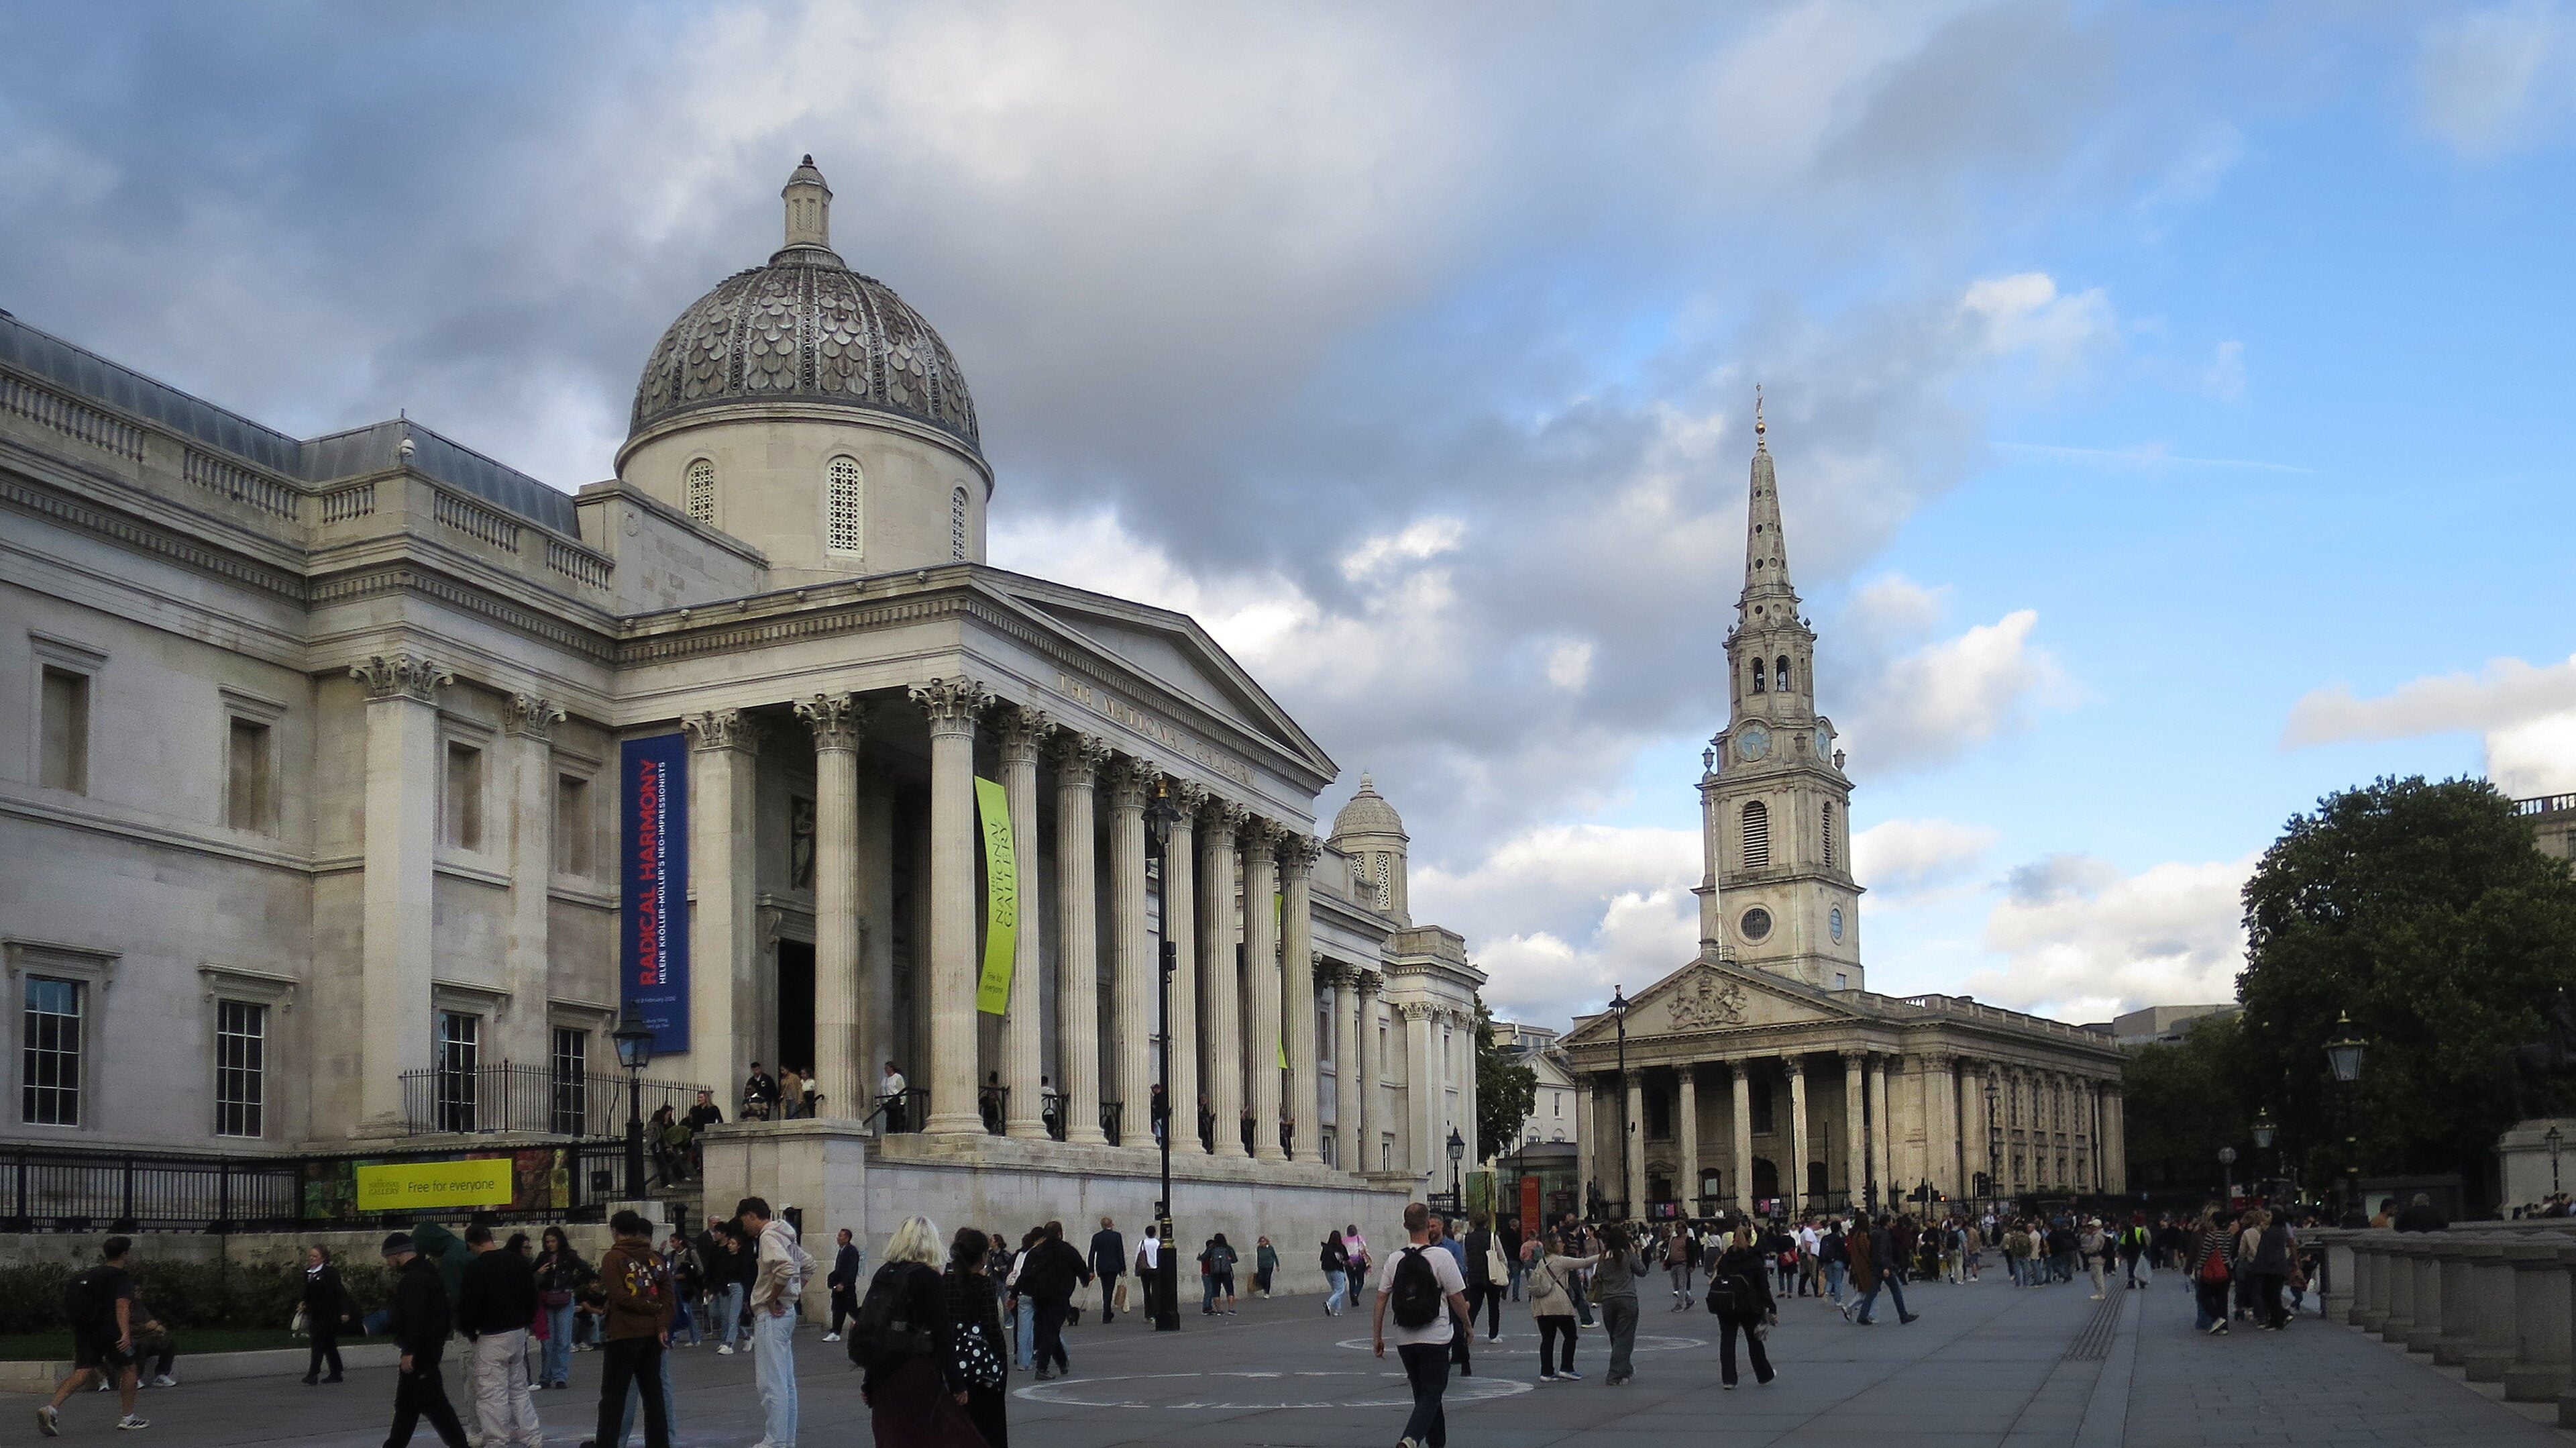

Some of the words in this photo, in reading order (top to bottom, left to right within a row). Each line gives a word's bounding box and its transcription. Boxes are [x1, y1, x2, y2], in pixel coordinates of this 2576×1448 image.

[1058, 672, 1092, 706] THE
[1104, 695, 1185, 752] NATIONAL
[1195, 742, 1256, 786] GALLERY
[639, 759, 657, 880] HARMONY
[657, 762, 666, 858] NEO-IMPRESSIONISTS
[989, 820, 1004, 925] NATIONAL
[994, 819, 1013, 928] GALLERY
[639, 886, 657, 986] RADICAL
[657, 950, 666, 984] HELENE
[408, 1182, 429, 1193] Free
[433, 1180, 447, 1192] for
[449, 1180, 495, 1193] everyone
